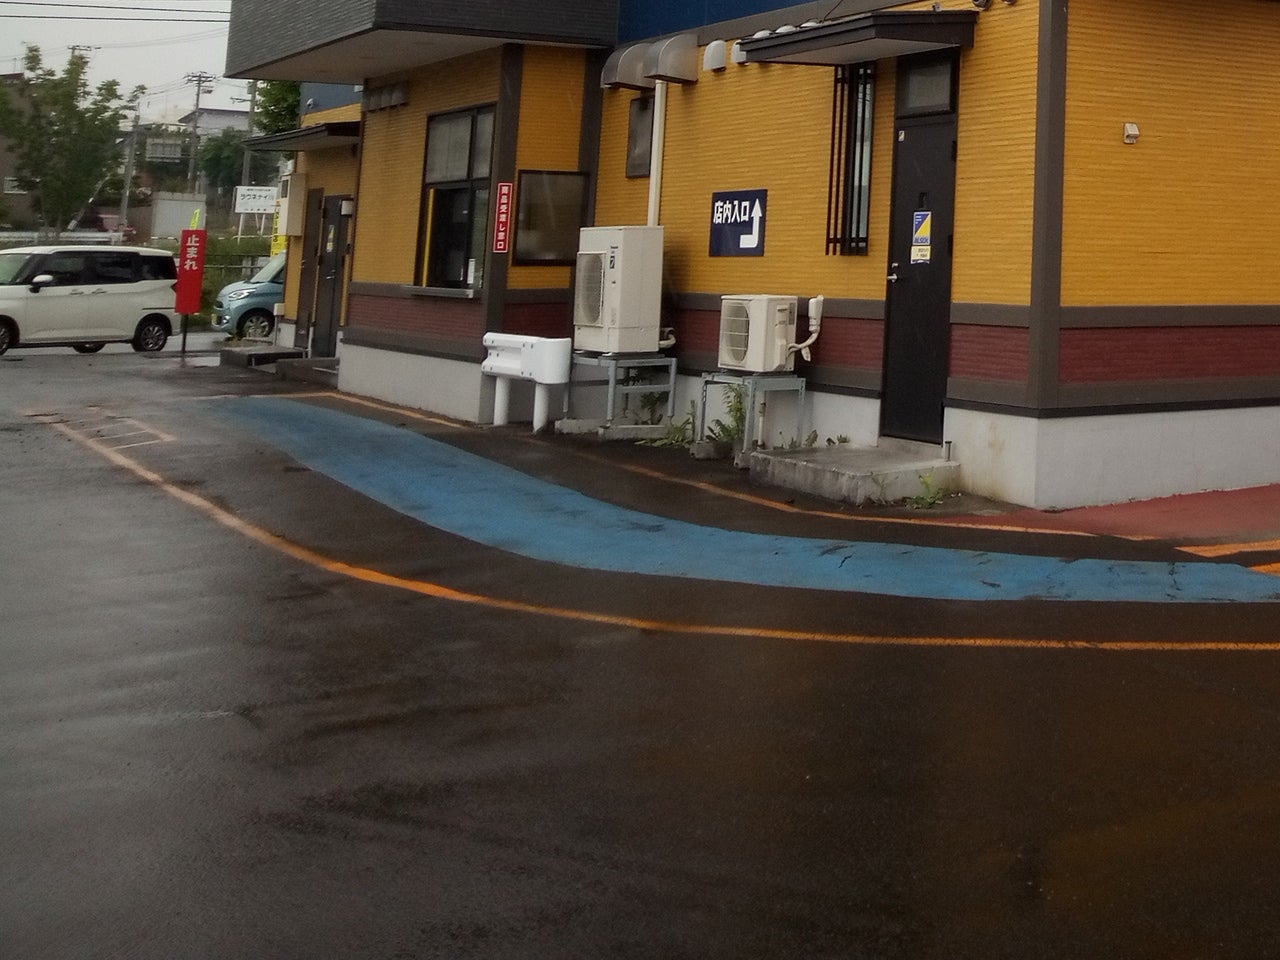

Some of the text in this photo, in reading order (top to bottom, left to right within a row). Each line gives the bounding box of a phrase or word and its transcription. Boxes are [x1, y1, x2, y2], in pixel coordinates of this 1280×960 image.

[713, 200, 750, 224] 店内入口
[184, 234, 200, 271] 止まれ
